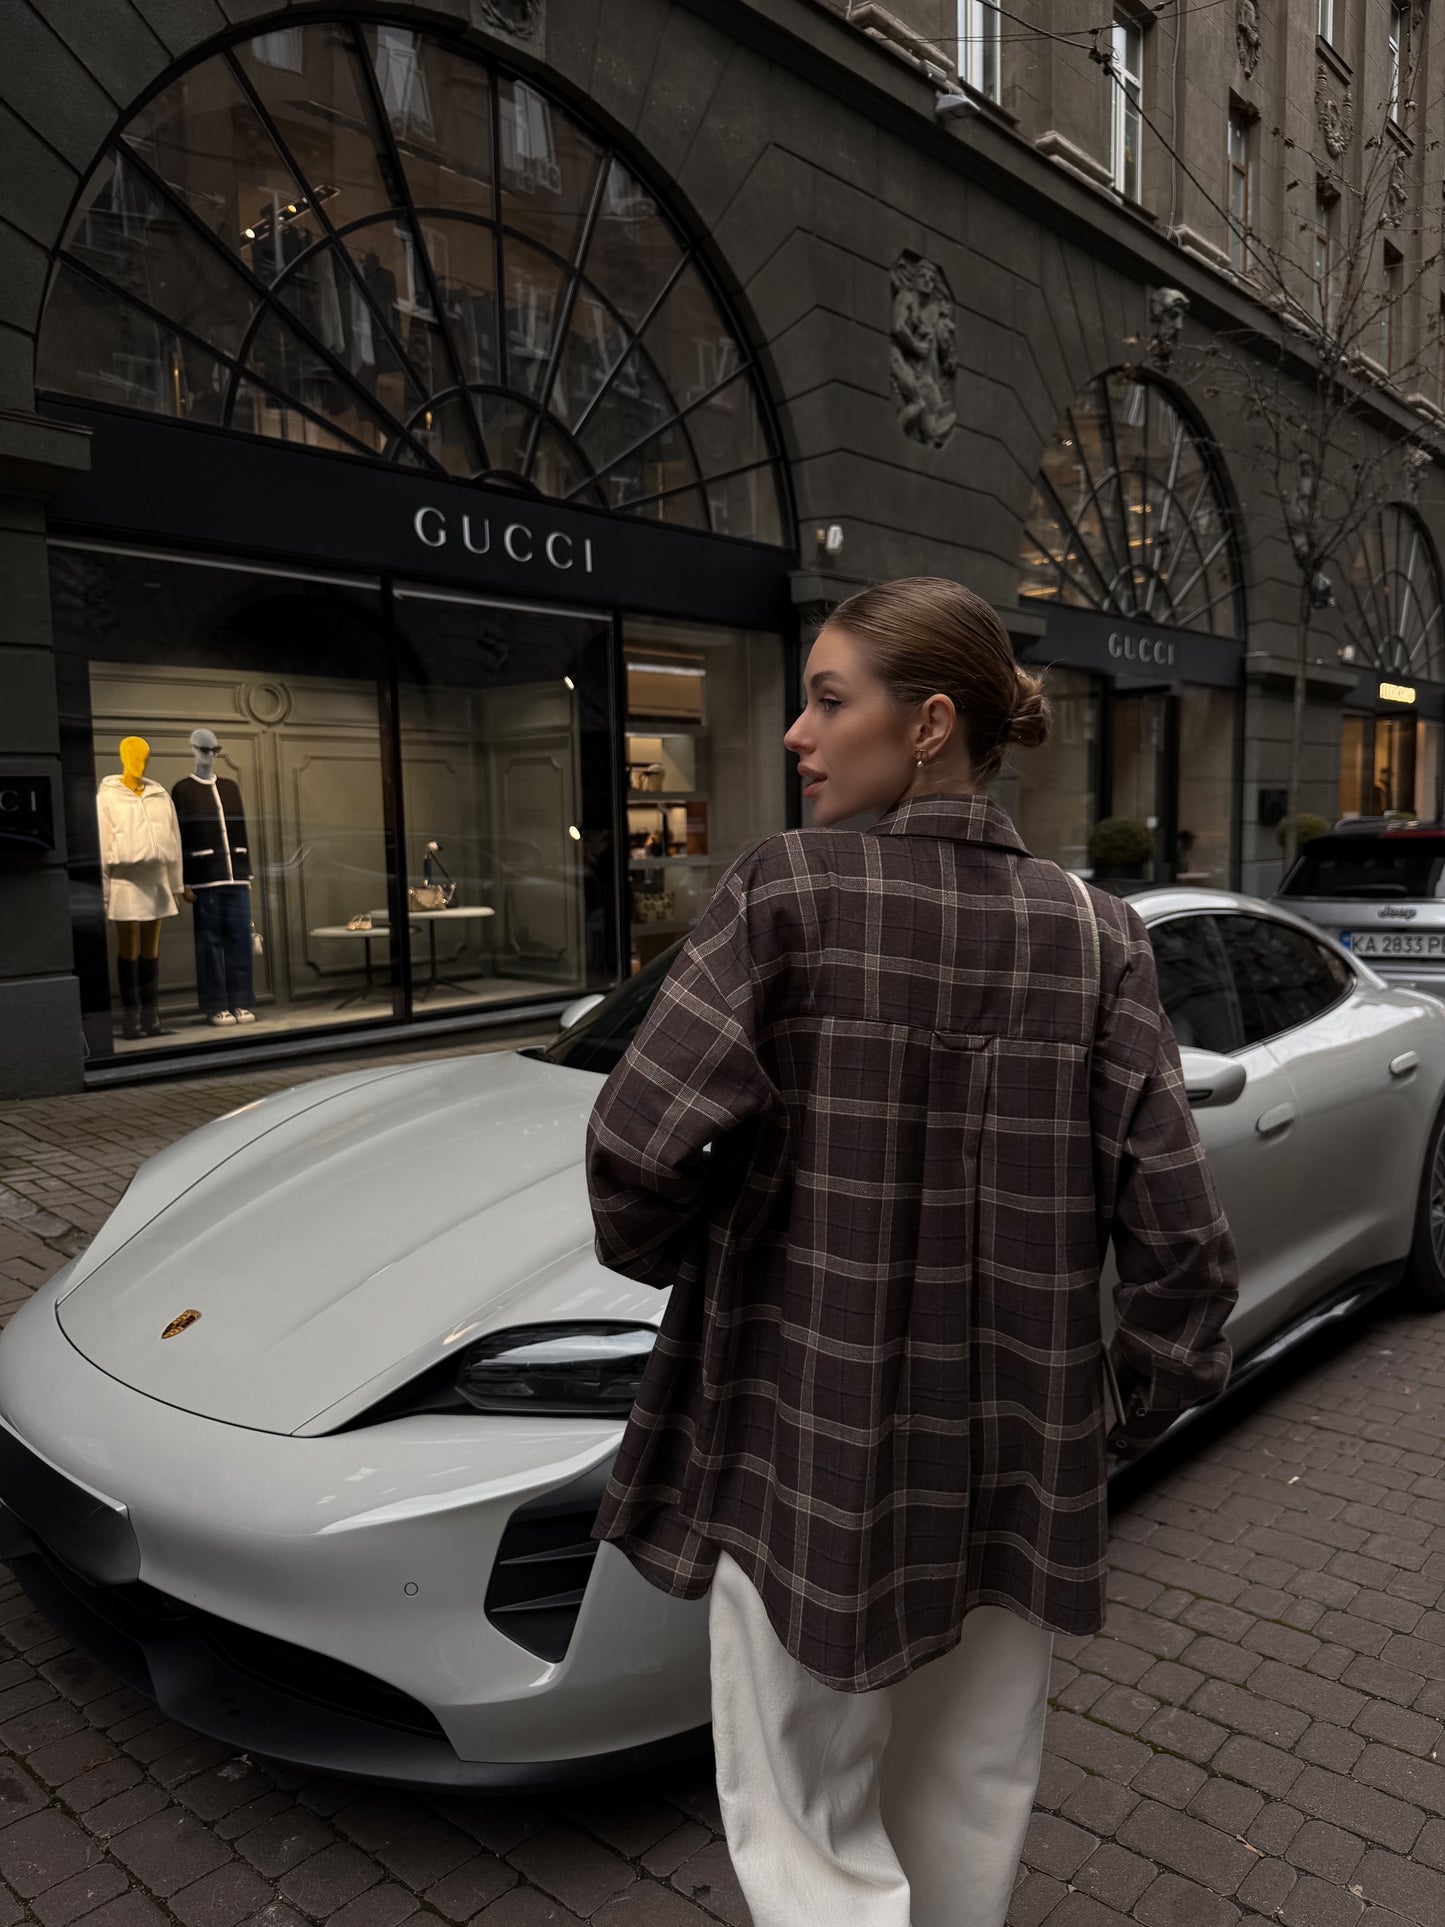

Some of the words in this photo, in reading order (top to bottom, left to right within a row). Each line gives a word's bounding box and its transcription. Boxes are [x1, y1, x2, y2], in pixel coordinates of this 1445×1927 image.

[413, 505, 593, 574] GUCCI
[1108, 631, 1175, 666] GUCCI
[1352, 935, 1377, 953] KA
[1382, 935, 1422, 953] 2833
